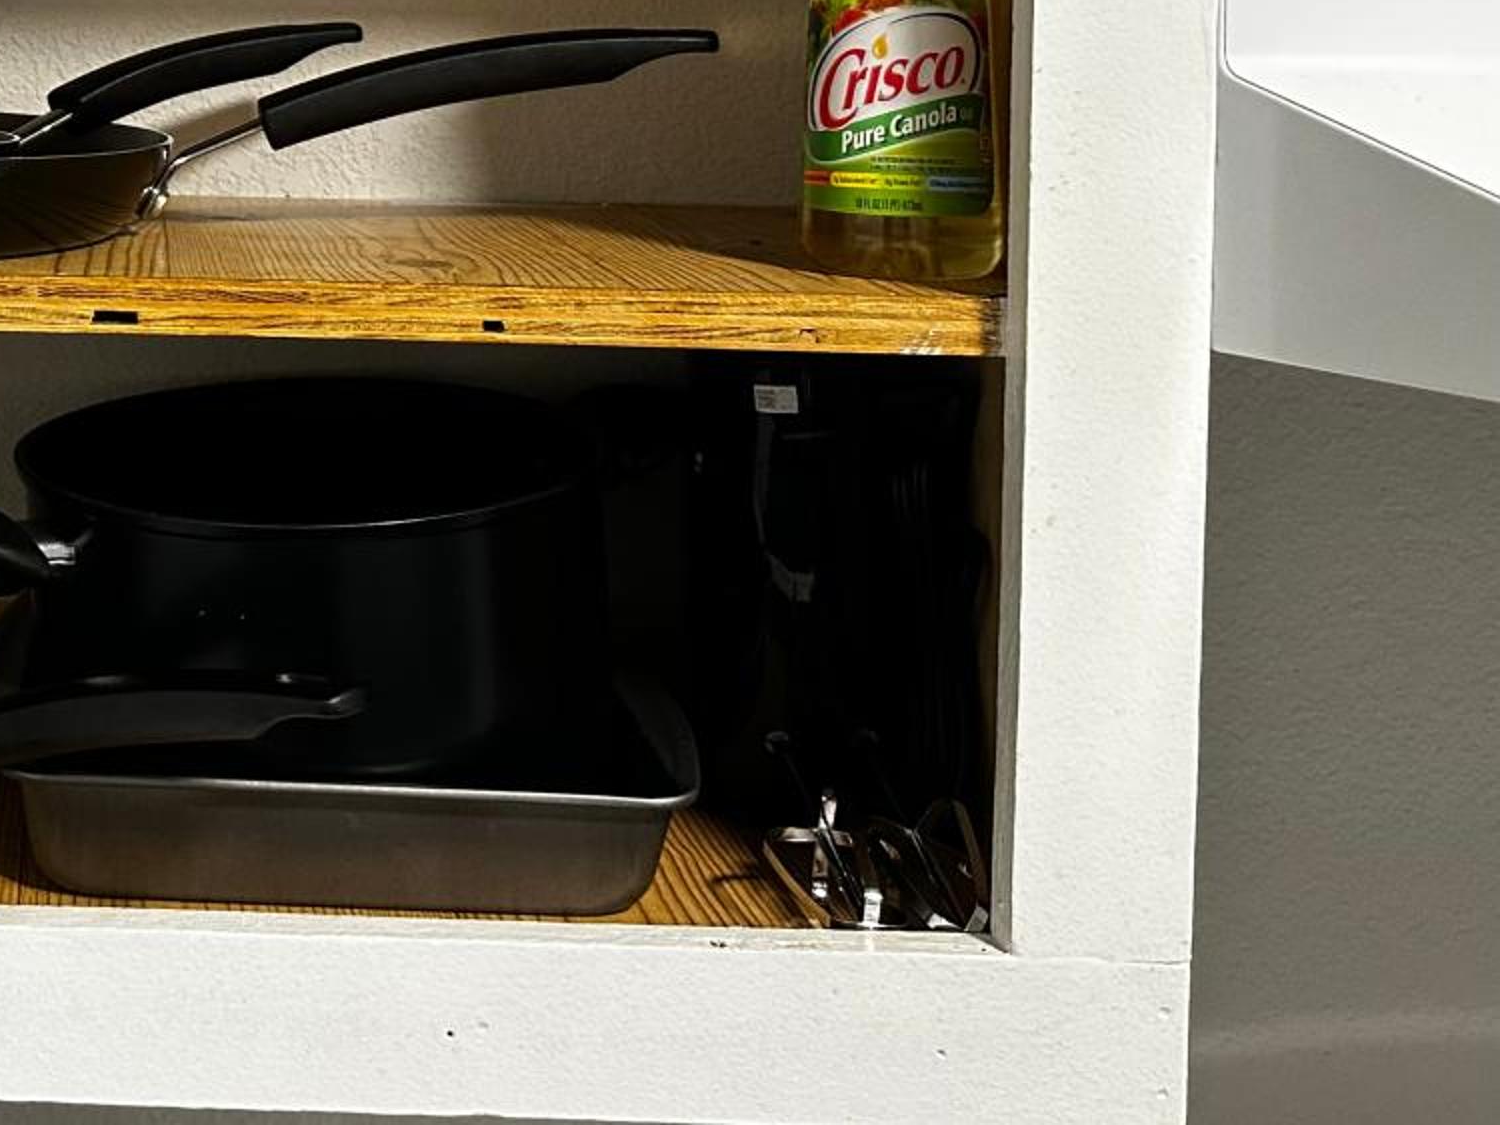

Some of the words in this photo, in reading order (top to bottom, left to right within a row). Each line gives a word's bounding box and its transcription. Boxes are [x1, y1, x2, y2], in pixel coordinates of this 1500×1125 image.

[819, 46, 964, 130] Crisco
[841, 124, 885, 154] Pure
[889, 102, 957, 139] Canola
